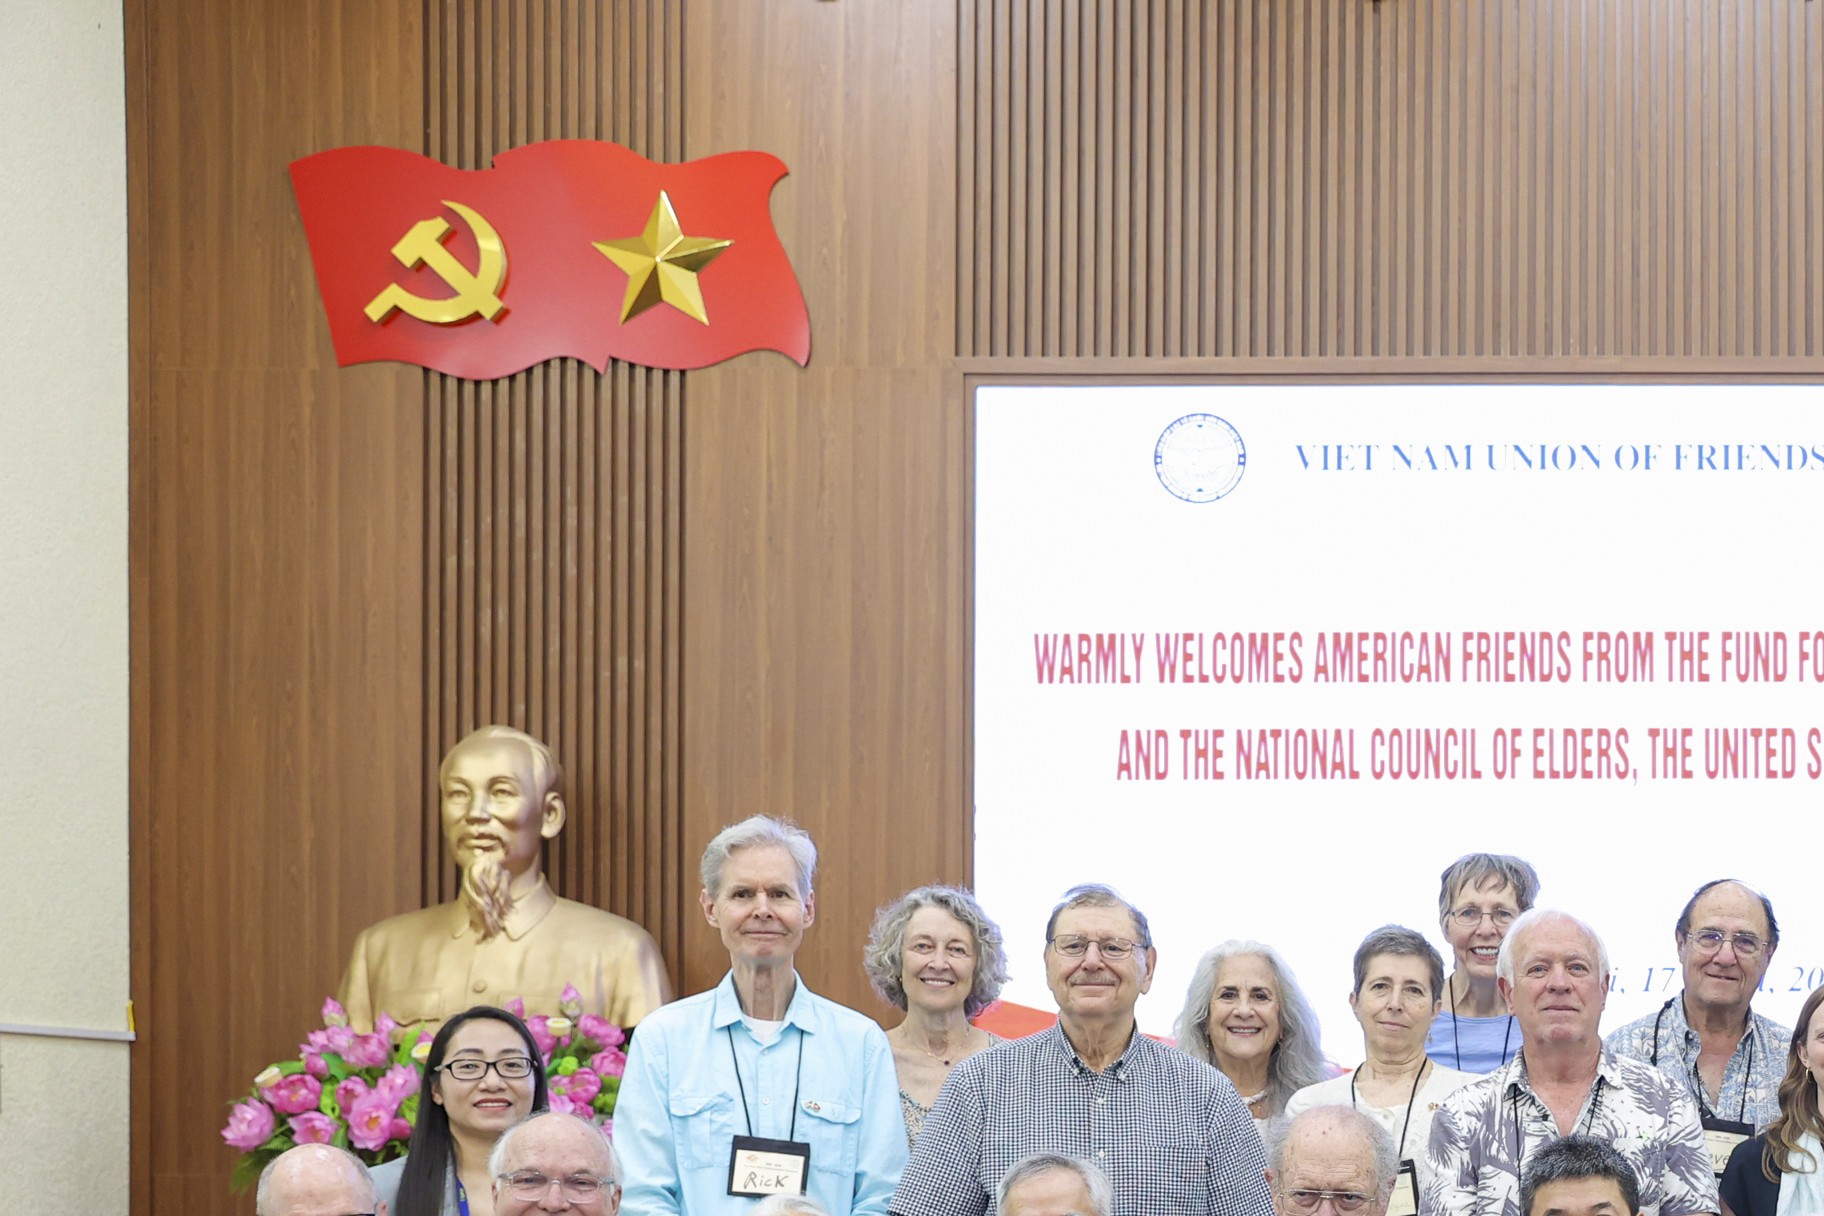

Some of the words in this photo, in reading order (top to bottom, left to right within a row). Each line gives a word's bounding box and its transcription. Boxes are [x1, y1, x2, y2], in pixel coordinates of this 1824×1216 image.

[1295, 444, 1380, 472] VIET
[1390, 444, 1472, 472] NAM
[1487, 444, 1601, 472] UNION
[1614, 444, 1662, 472] OF
[1034, 631, 1144, 684] WARMLY
[1156, 631, 1303, 684] WELCOMES
[1314, 631, 1451, 684] AMERICAN
[1462, 631, 1571, 684] FRIENDS
[1583, 631, 1654, 684] FROM
[1665, 631, 1710, 684] THE
[1722, 631, 1787, 684] FUND
[1117, 728, 1168, 780] AND
[1180, 728, 1224, 780] THE
[1236, 728, 1360, 780] NATIONAL
[1371, 728, 1482, 780] COUNCIL
[1493, 728, 1522, 780] OF
[1533, 728, 1637, 786] ELDERS,
[1648, 728, 1693, 780] THE
[1705, 728, 1796, 780] UNITED
[1642, 967, 1675, 992] 17
